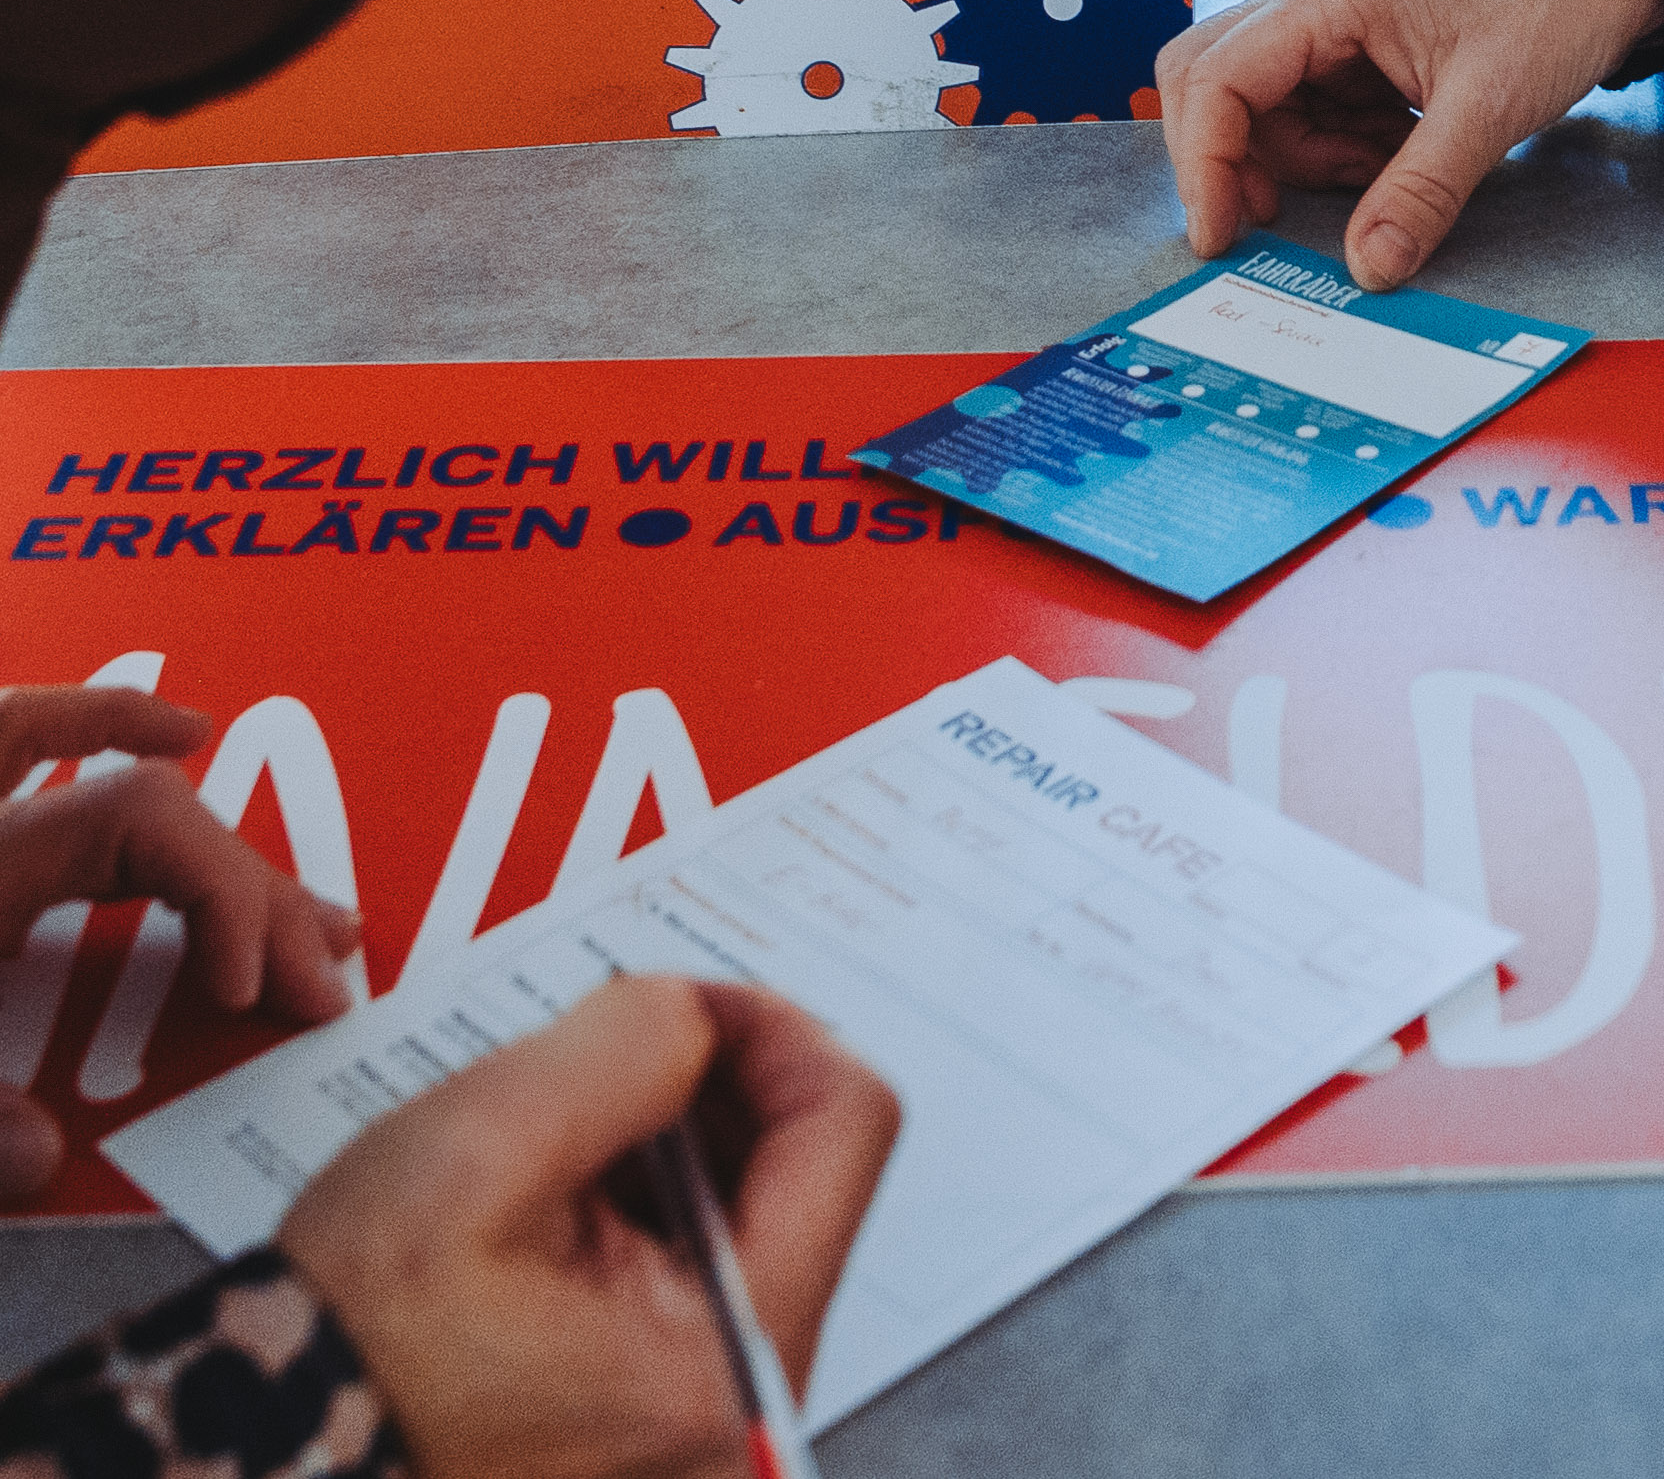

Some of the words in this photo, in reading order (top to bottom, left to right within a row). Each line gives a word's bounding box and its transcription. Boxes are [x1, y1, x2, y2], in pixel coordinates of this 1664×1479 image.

[1236, 250, 1363, 310] FAHRRÄDER
[44, 444, 576, 495] HERZLICH
[9, 498, 592, 563] ERKLÄREN
[936, 709, 1101, 812] REPAIR
[1097, 802, 1224, 882] CAFE
